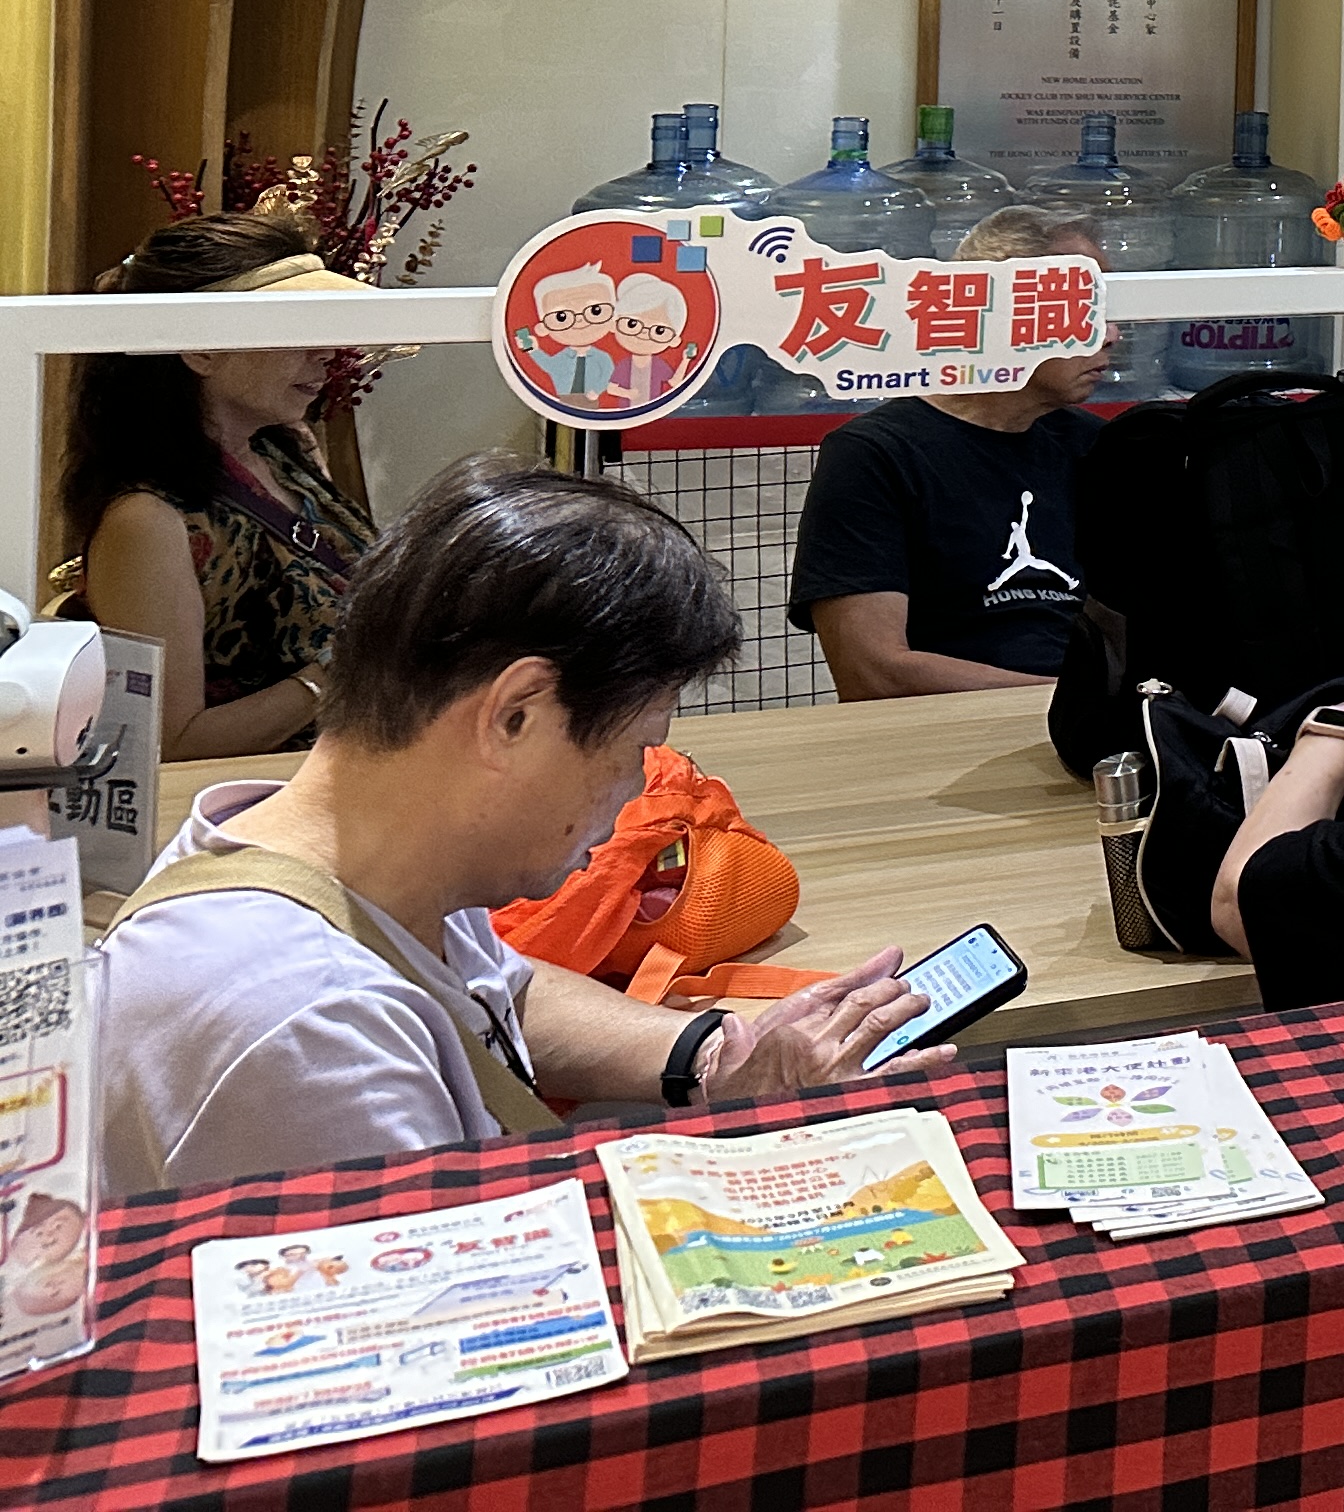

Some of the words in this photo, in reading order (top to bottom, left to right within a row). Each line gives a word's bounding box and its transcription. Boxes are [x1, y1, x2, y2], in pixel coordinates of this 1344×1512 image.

[1041, 76, 1060, 84] NEW
[1062, 76, 1087, 84] HOME
[1089, 76, 1143, 84] ASSOCIATION
[774, 258, 1100, 362] 友智識
[1181, 323, 1286, 350] TIPTOP
[836, 368, 930, 391] Smart
[939, 363, 1026, 387] Silver
[983, 588, 1036, 607] HONG
[50, 778, 138, 835] 動區
